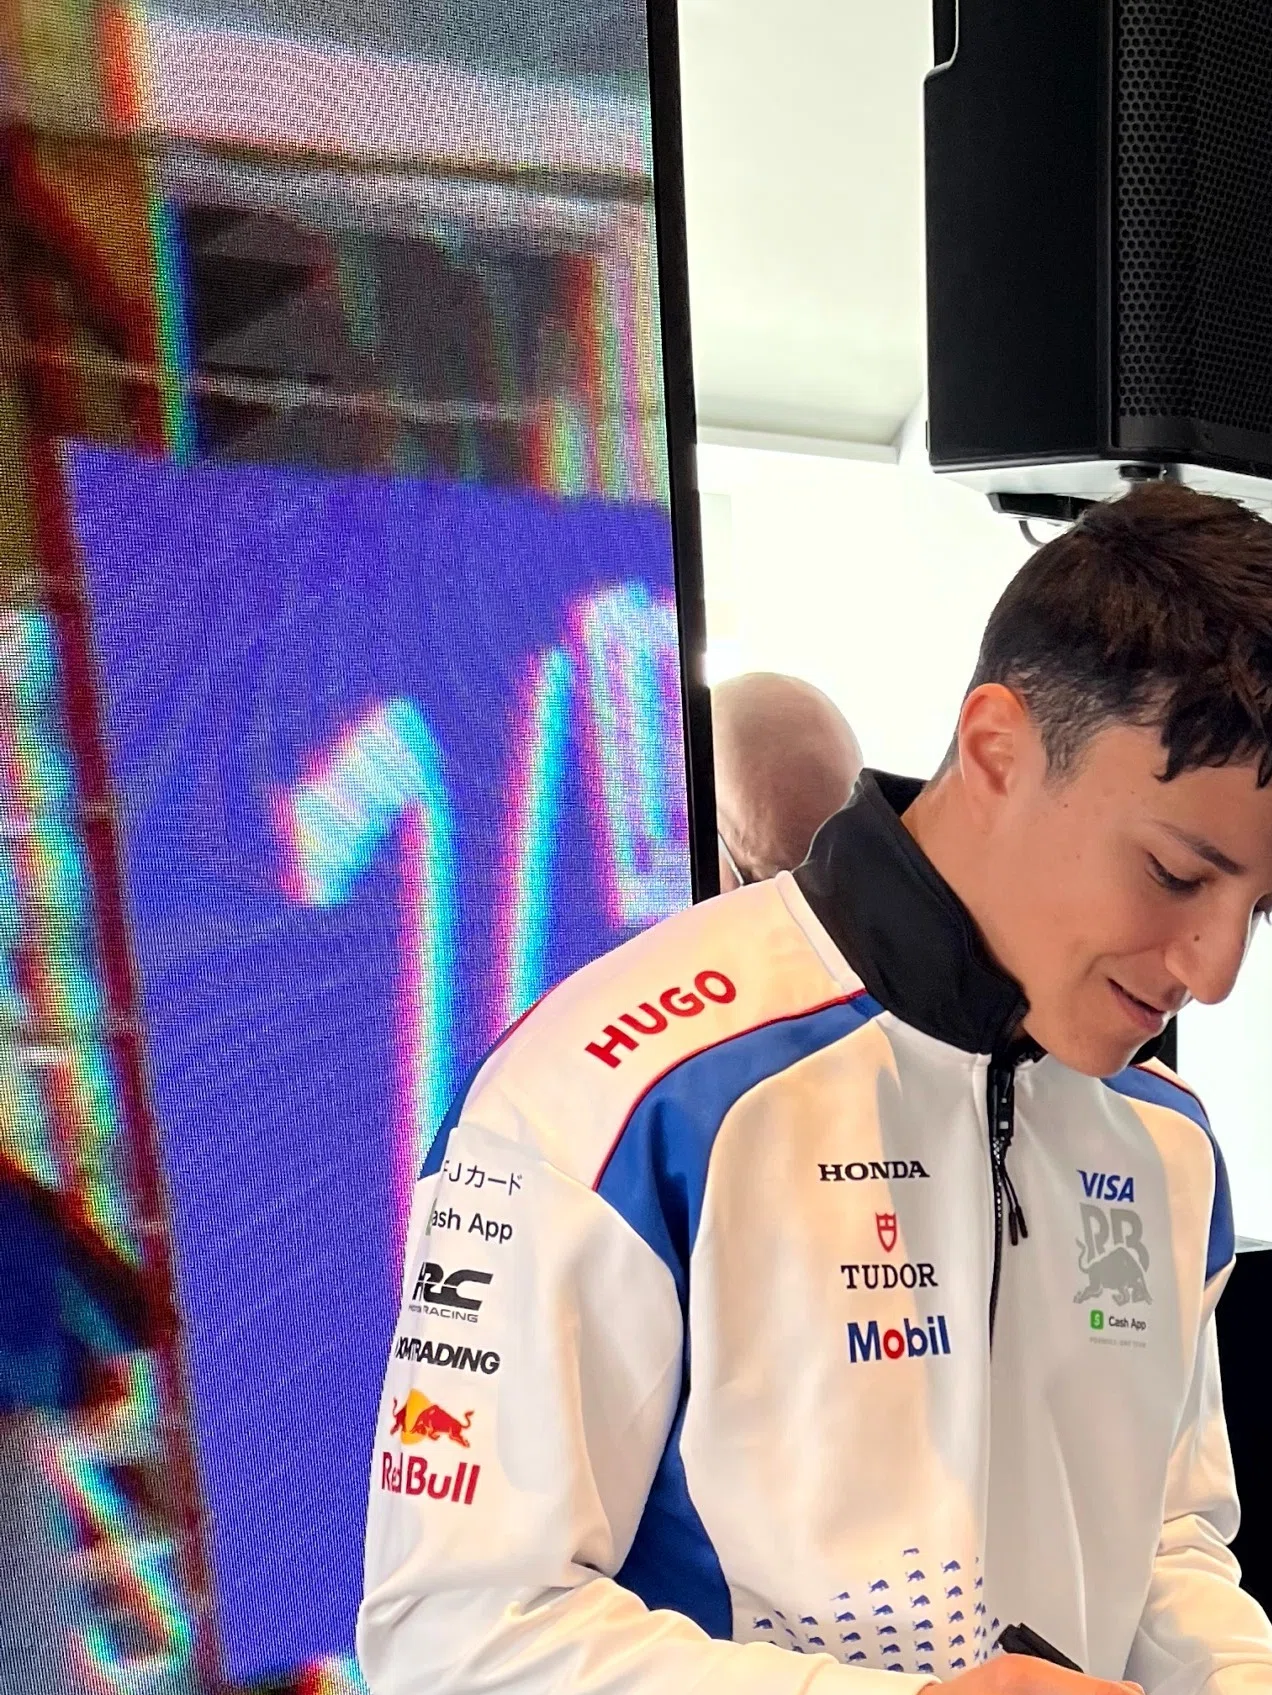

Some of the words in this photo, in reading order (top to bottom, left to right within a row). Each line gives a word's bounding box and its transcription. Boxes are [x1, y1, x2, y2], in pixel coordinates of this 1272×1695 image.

[584, 968, 738, 1070] HUGO
[818, 1160, 930, 1182] HONDA
[1076, 1168, 1135, 1202] VISA
[431, 1207, 462, 1231] ash
[468, 1213, 514, 1244] App
[840, 1263, 938, 1290] TUDOR
[847, 1315, 951, 1363] Mobil
[1108, 1316, 1129, 1328] Cash
[1130, 1318, 1147, 1331] App
[405, 1455, 480, 1505] Bull
